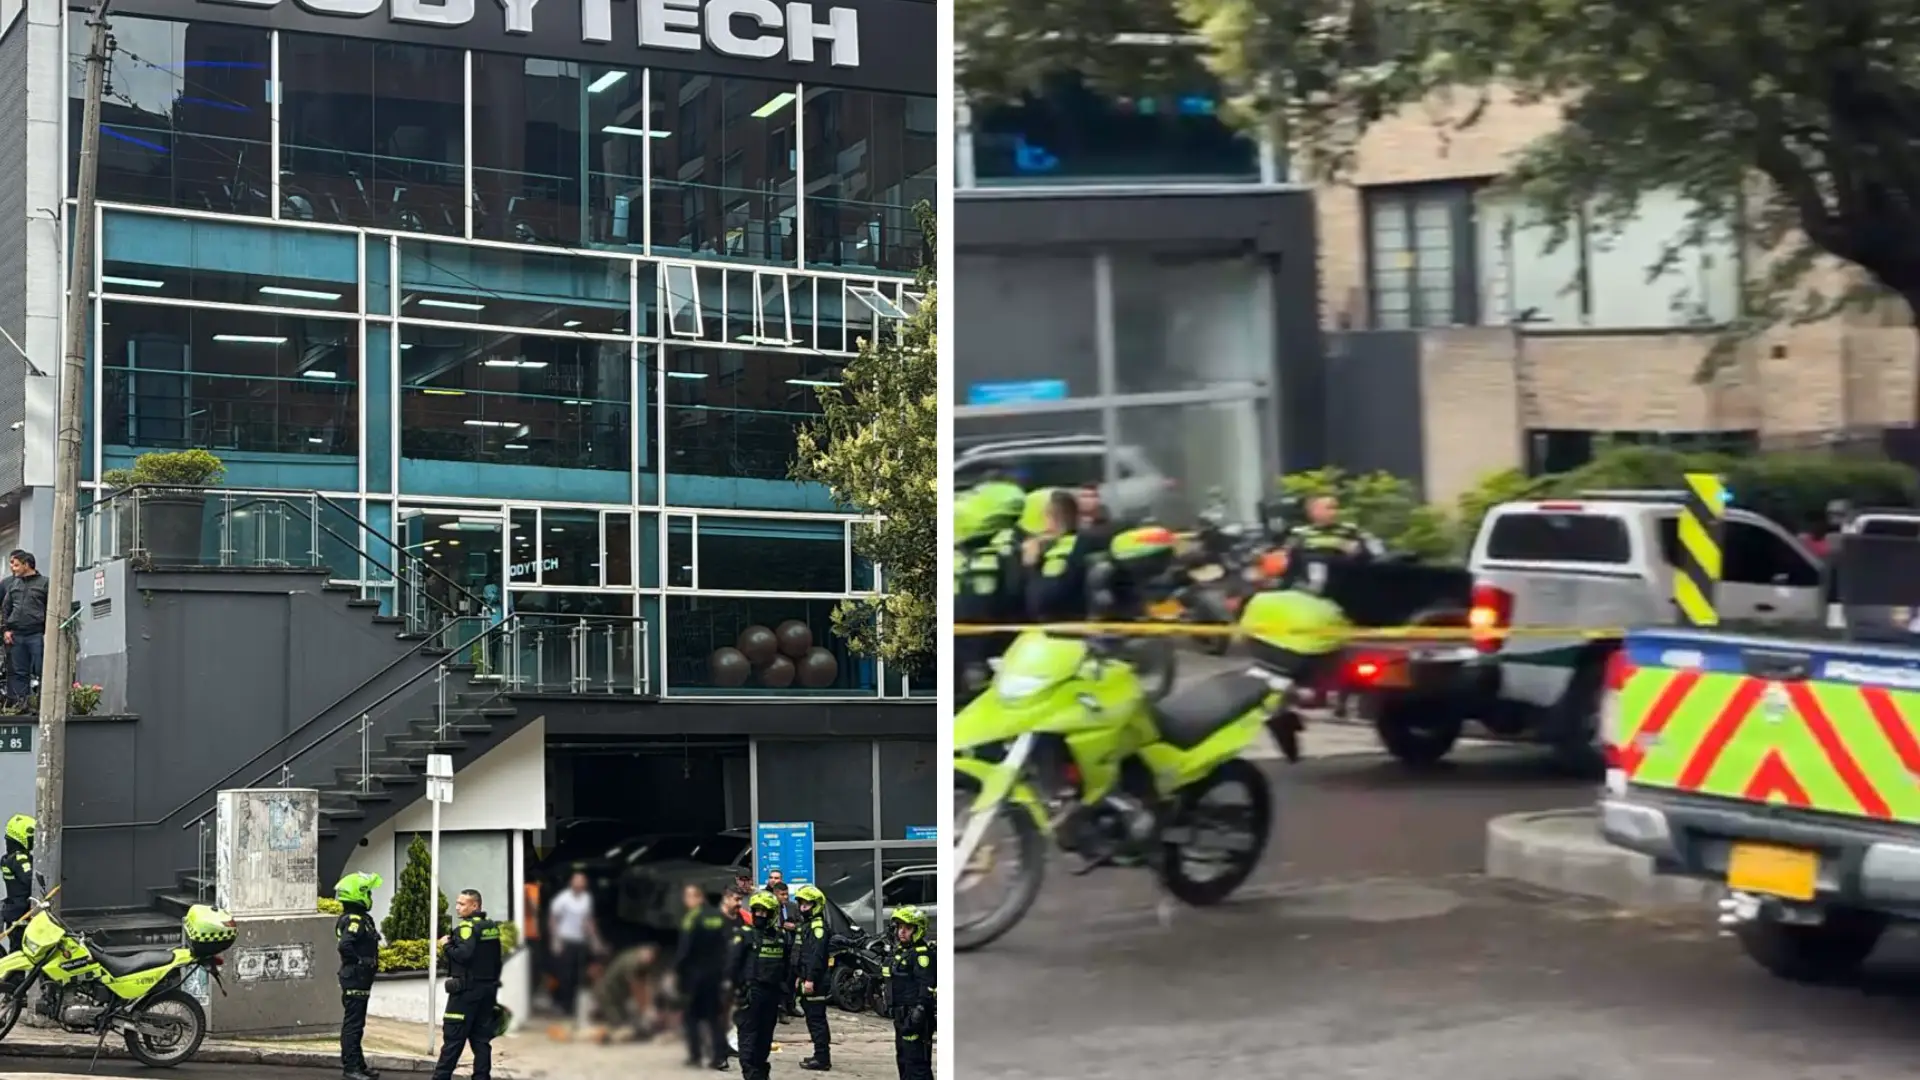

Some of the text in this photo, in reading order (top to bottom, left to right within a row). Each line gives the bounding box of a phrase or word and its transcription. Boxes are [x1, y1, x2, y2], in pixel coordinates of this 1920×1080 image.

[198, 0, 859, 67] YTECH
[510, 557, 559, 577] ODYTCH
[10, 738, 22, 749] 85
